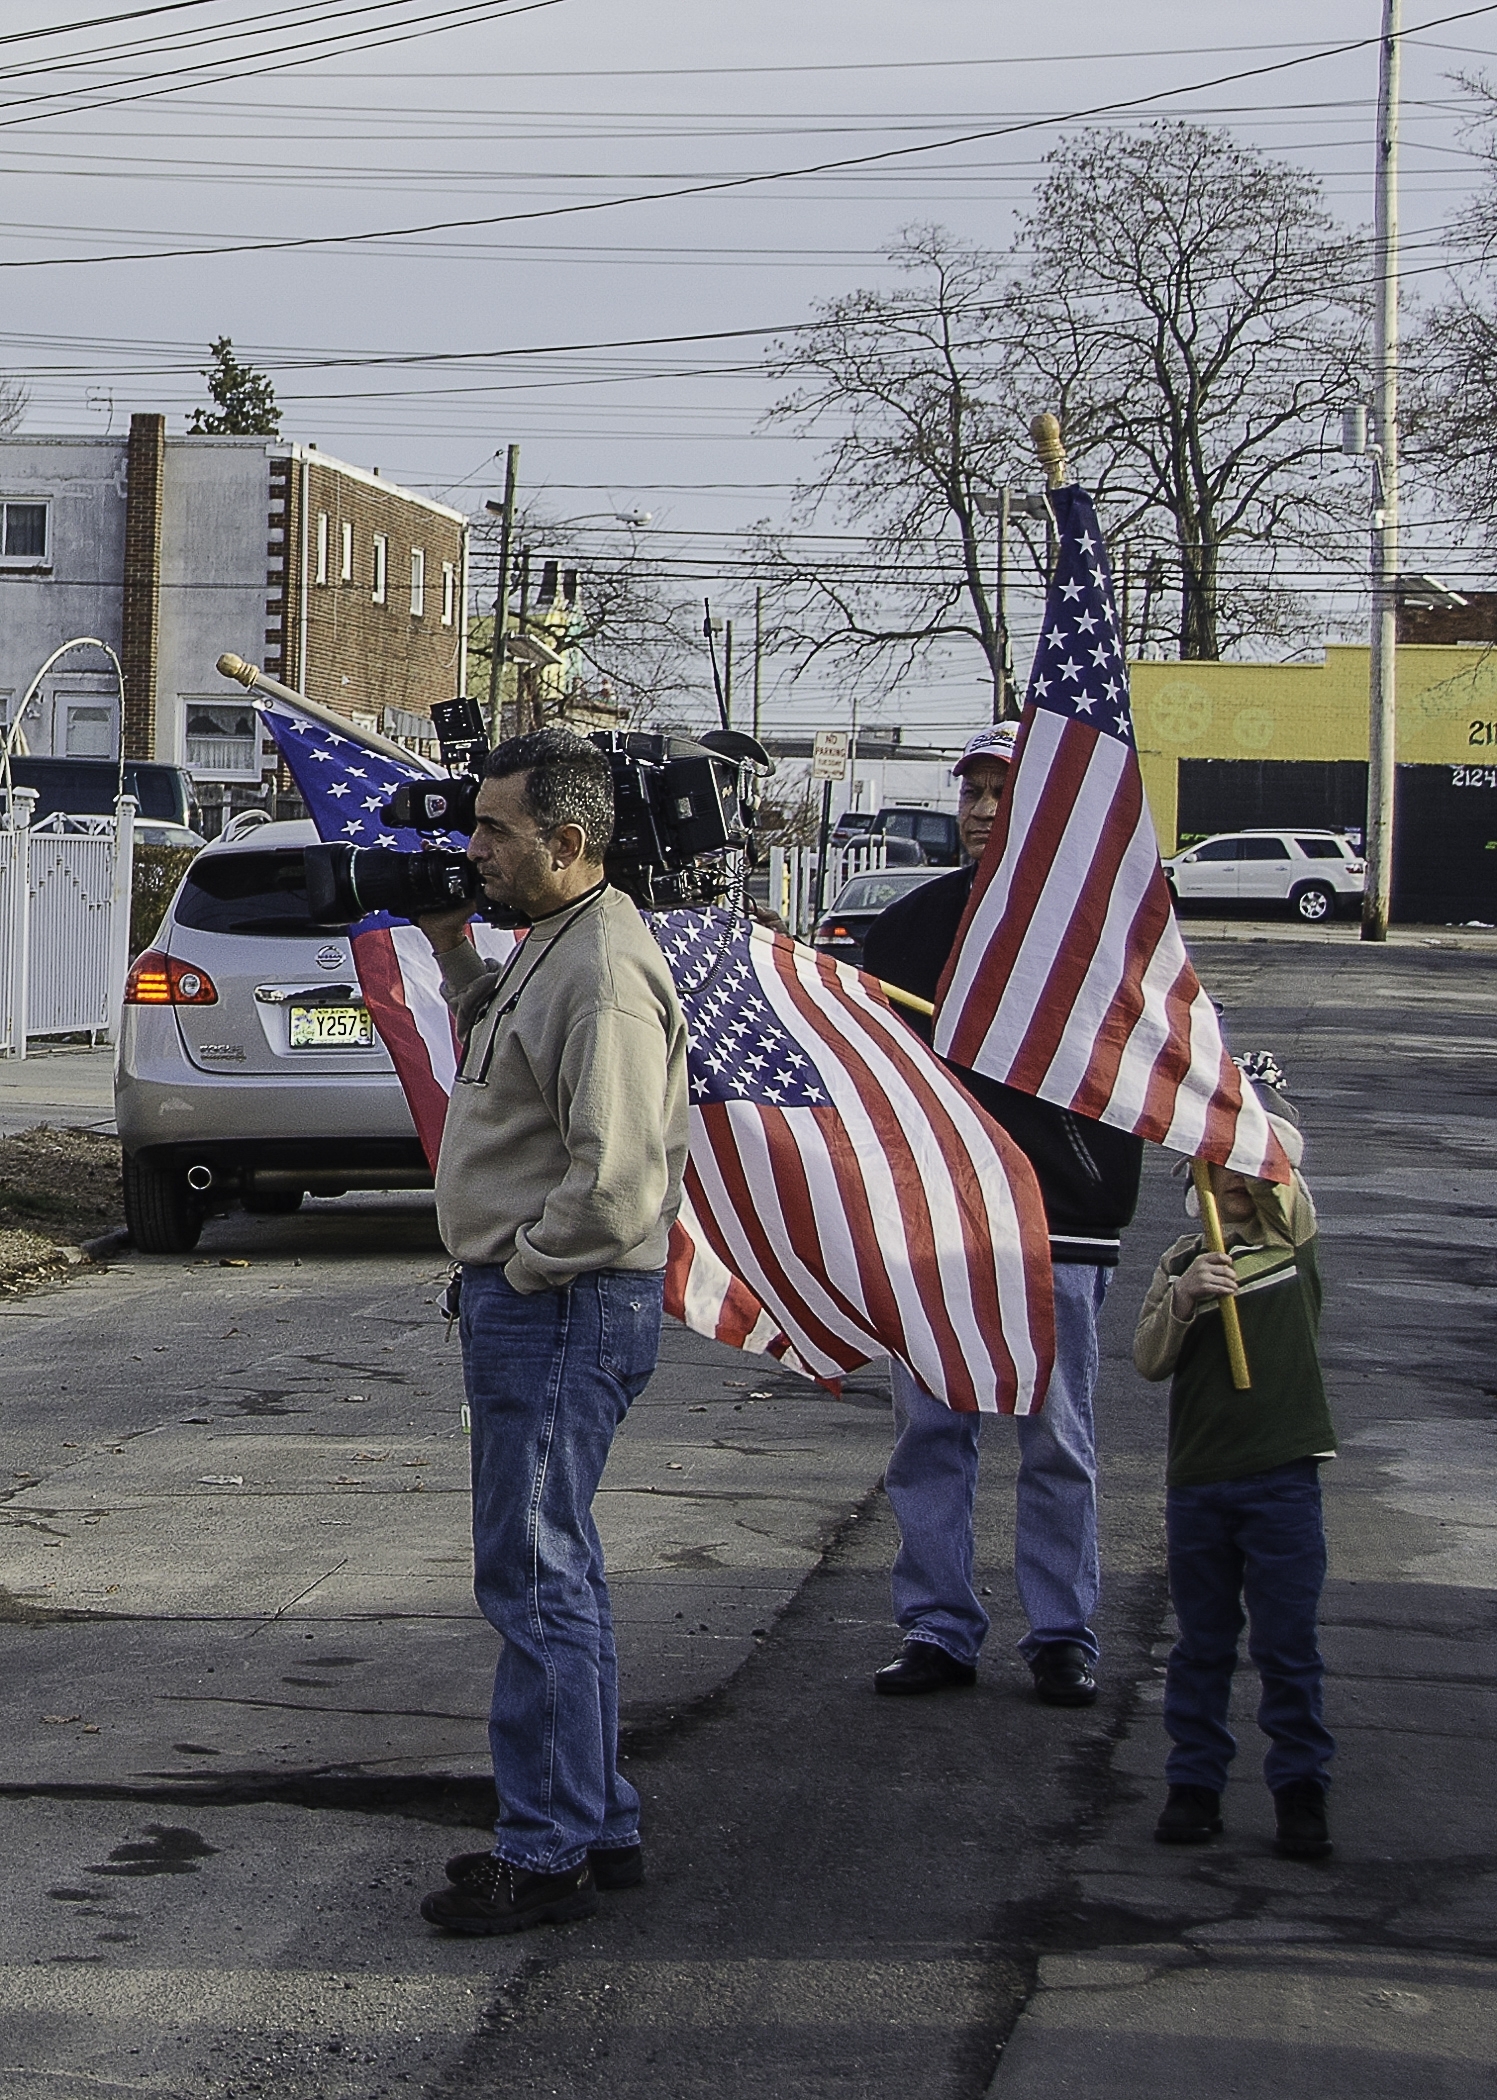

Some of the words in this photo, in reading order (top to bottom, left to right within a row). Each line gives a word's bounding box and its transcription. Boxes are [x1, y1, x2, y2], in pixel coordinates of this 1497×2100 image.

[825, 734, 838, 745] NO
[815, 746, 846, 758] PARKING
[1452, 769, 1496, 787] 2124
[316, 1015, 357, 1037] Y257
